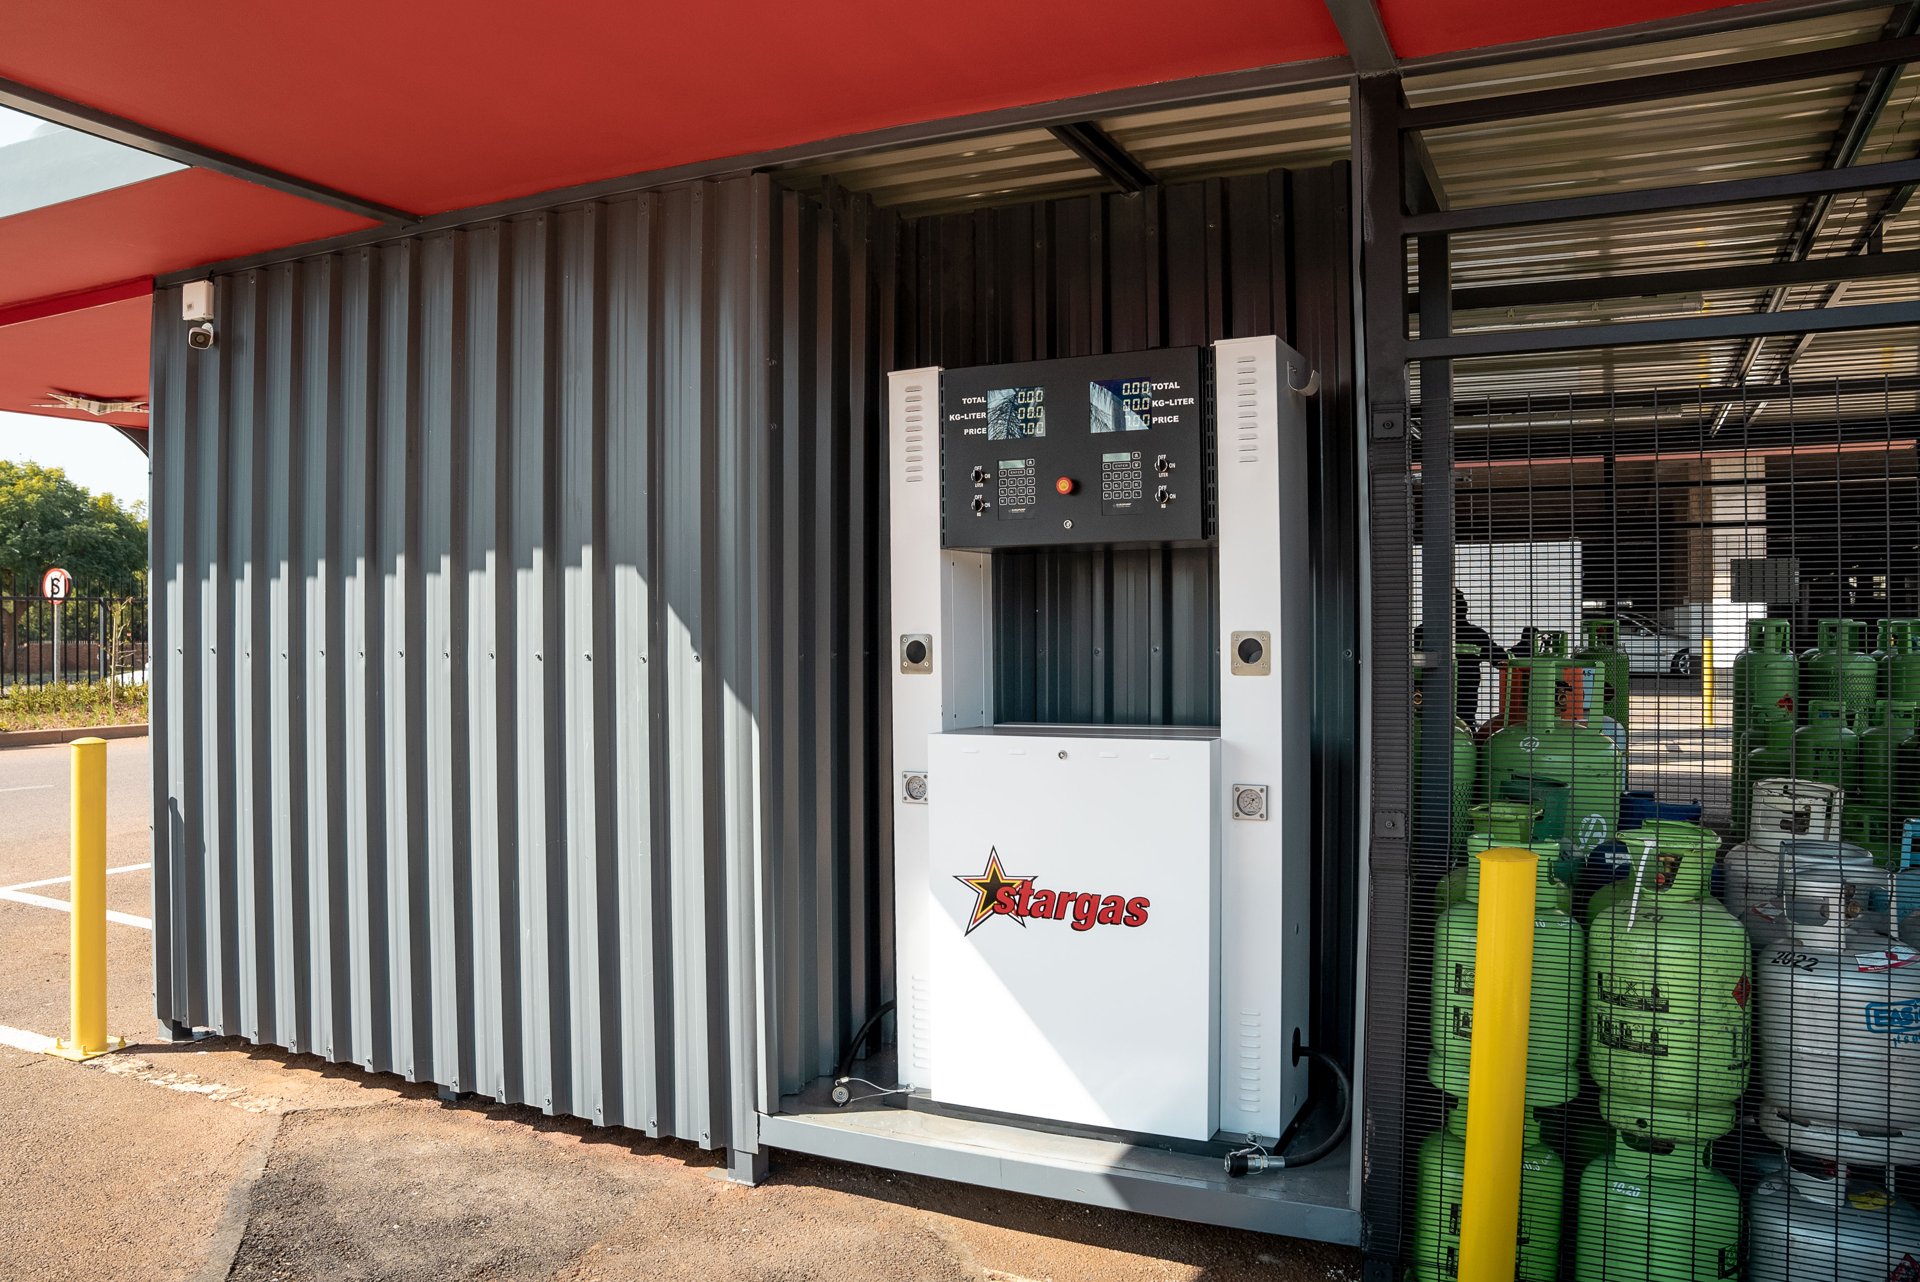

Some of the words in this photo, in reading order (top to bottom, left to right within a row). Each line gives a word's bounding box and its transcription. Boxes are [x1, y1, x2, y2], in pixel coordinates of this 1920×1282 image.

[1152, 381, 1180, 390] TOTAL
[962, 396, 986, 404] TOTAL
[1152, 398, 1194, 407] KG-LITER
[949, 412, 986, 421] KG-LITER
[1152, 415, 1179, 424] PRICE
[993, 878, 1151, 932] stargas
[1771, 950, 1820, 973] 2022
